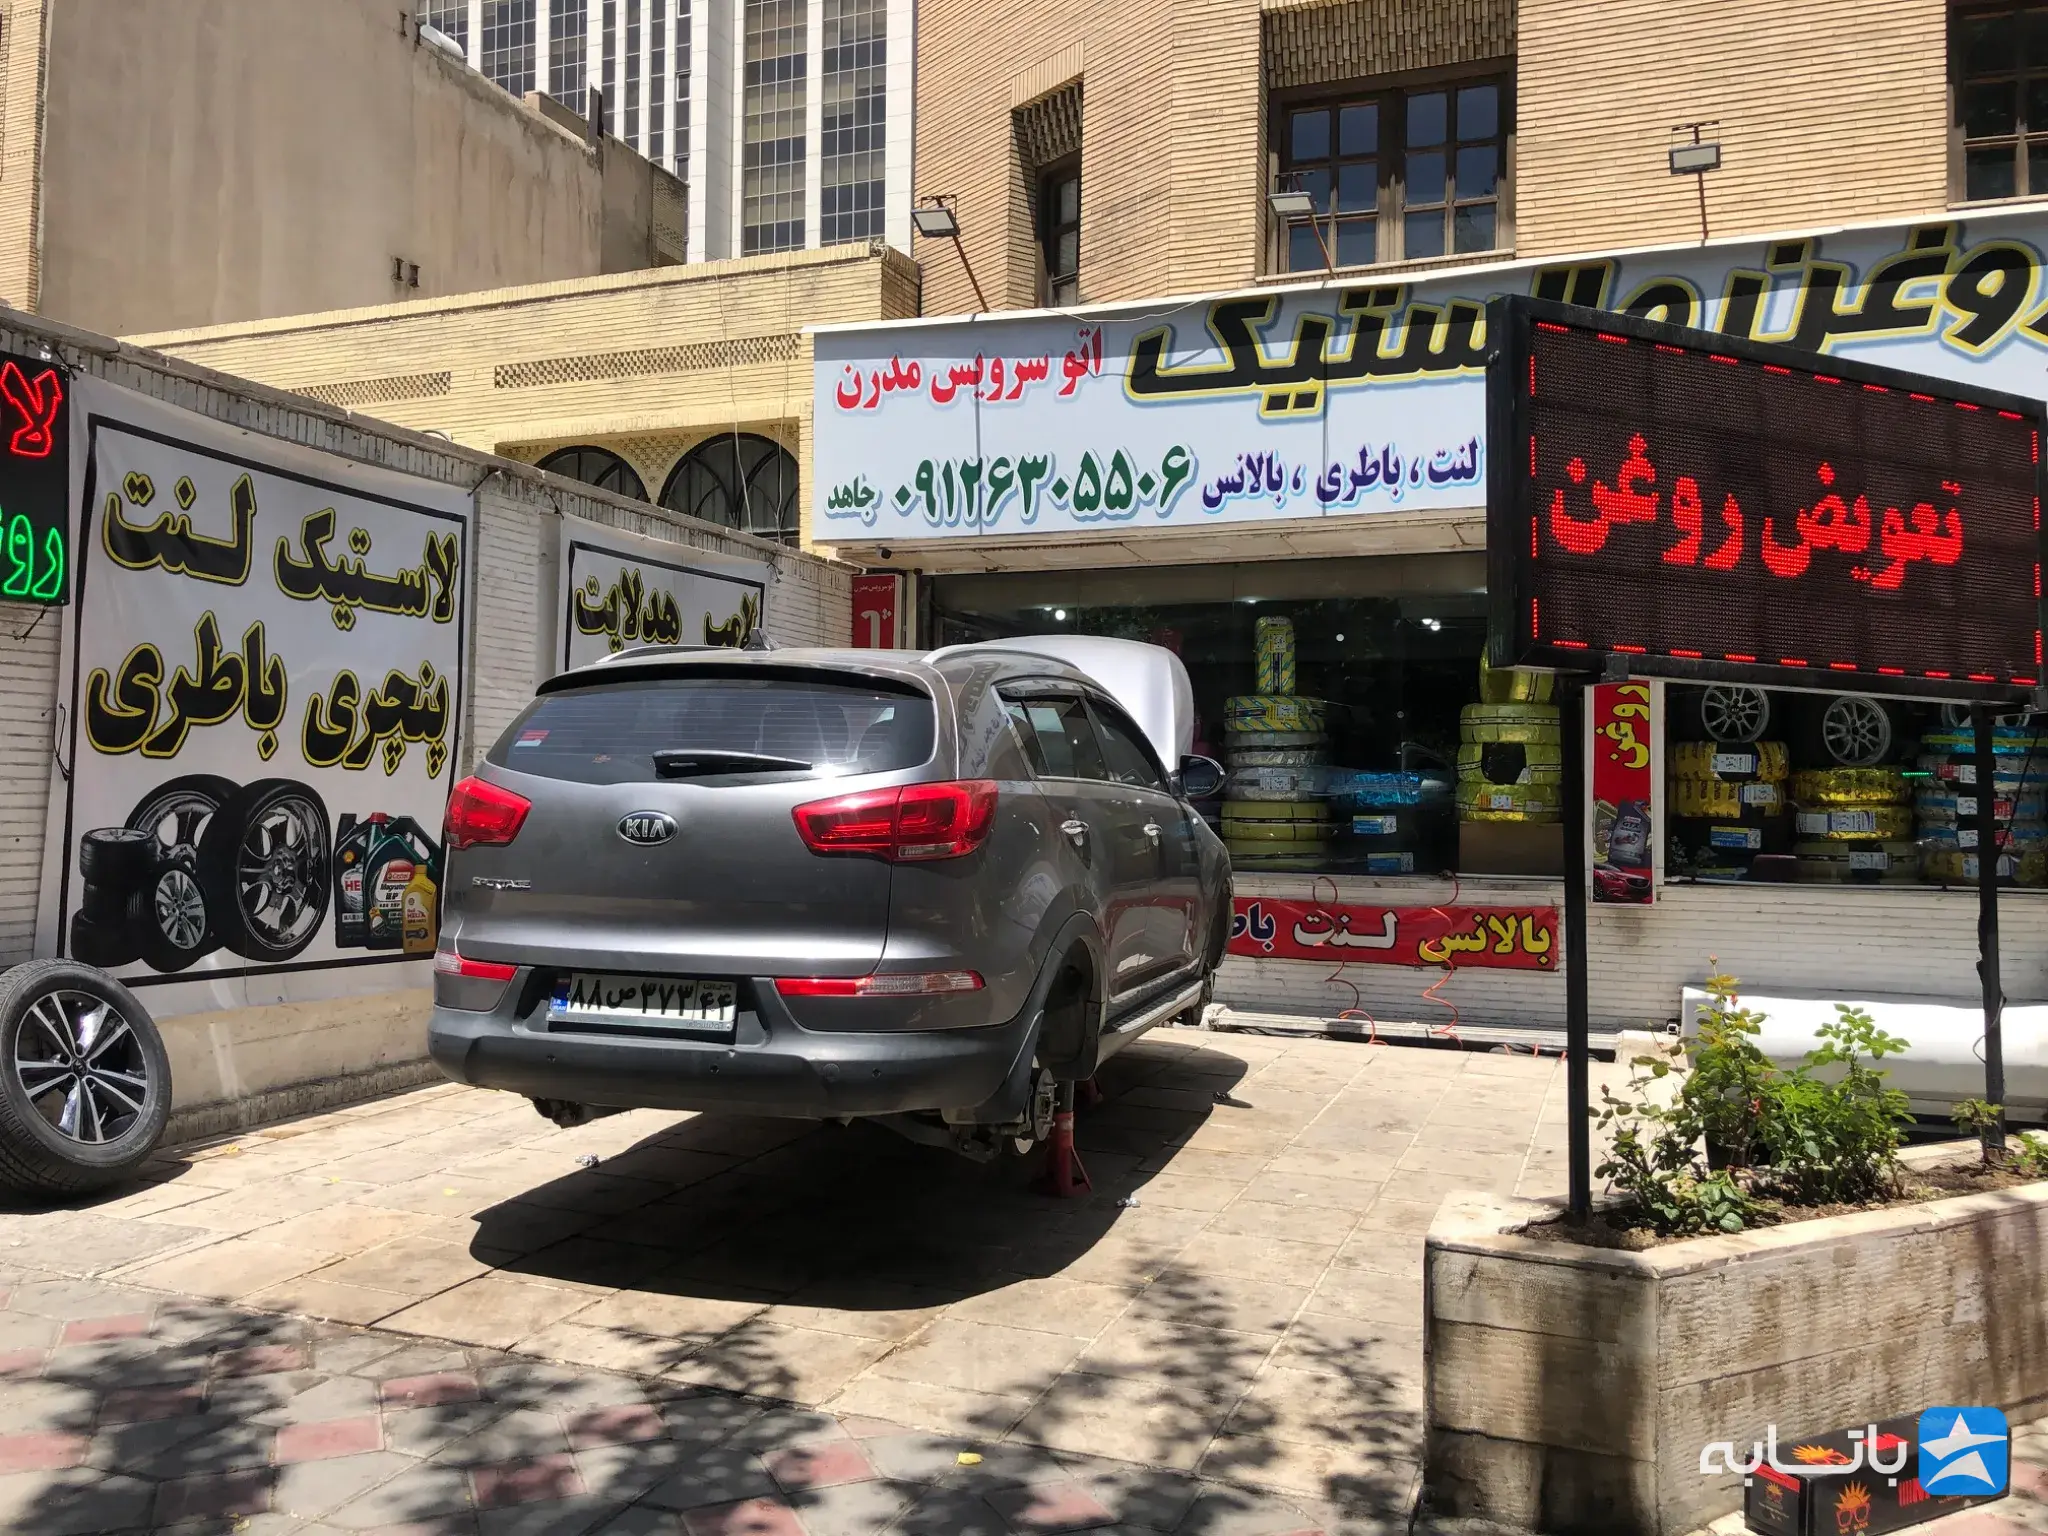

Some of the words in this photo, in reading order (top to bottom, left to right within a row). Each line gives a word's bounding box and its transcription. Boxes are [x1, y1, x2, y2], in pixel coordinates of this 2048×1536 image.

[1722, 222, 2048, 357] وغن
[836, 354, 922, 410] مدرن
[930, 352, 1050, 404] سرویس
[1058, 325, 1103, 396] اتو
[827, 474, 876, 518] جاهد
[894, 445, 1192, 520] ۰۹۱۲۶۳۰۵۵۰۶
[1202, 451, 1284, 509] بالانس
[1551, 433, 1743, 570] روغن
[103, 472, 257, 585] لنت
[1761, 462, 1963, 590] تعویض
[274, 507, 458, 631] لاستیک
[575, 567, 682, 653] هدلایت
[85, 609, 287, 762] باطری
[302, 660, 451, 778] پنچری
[1595, 684, 1650, 769] روغن
[626, 817, 666, 838] KIA
[1293, 901, 1398, 950] لنت
[1419, 904, 1550, 965] بالانس
